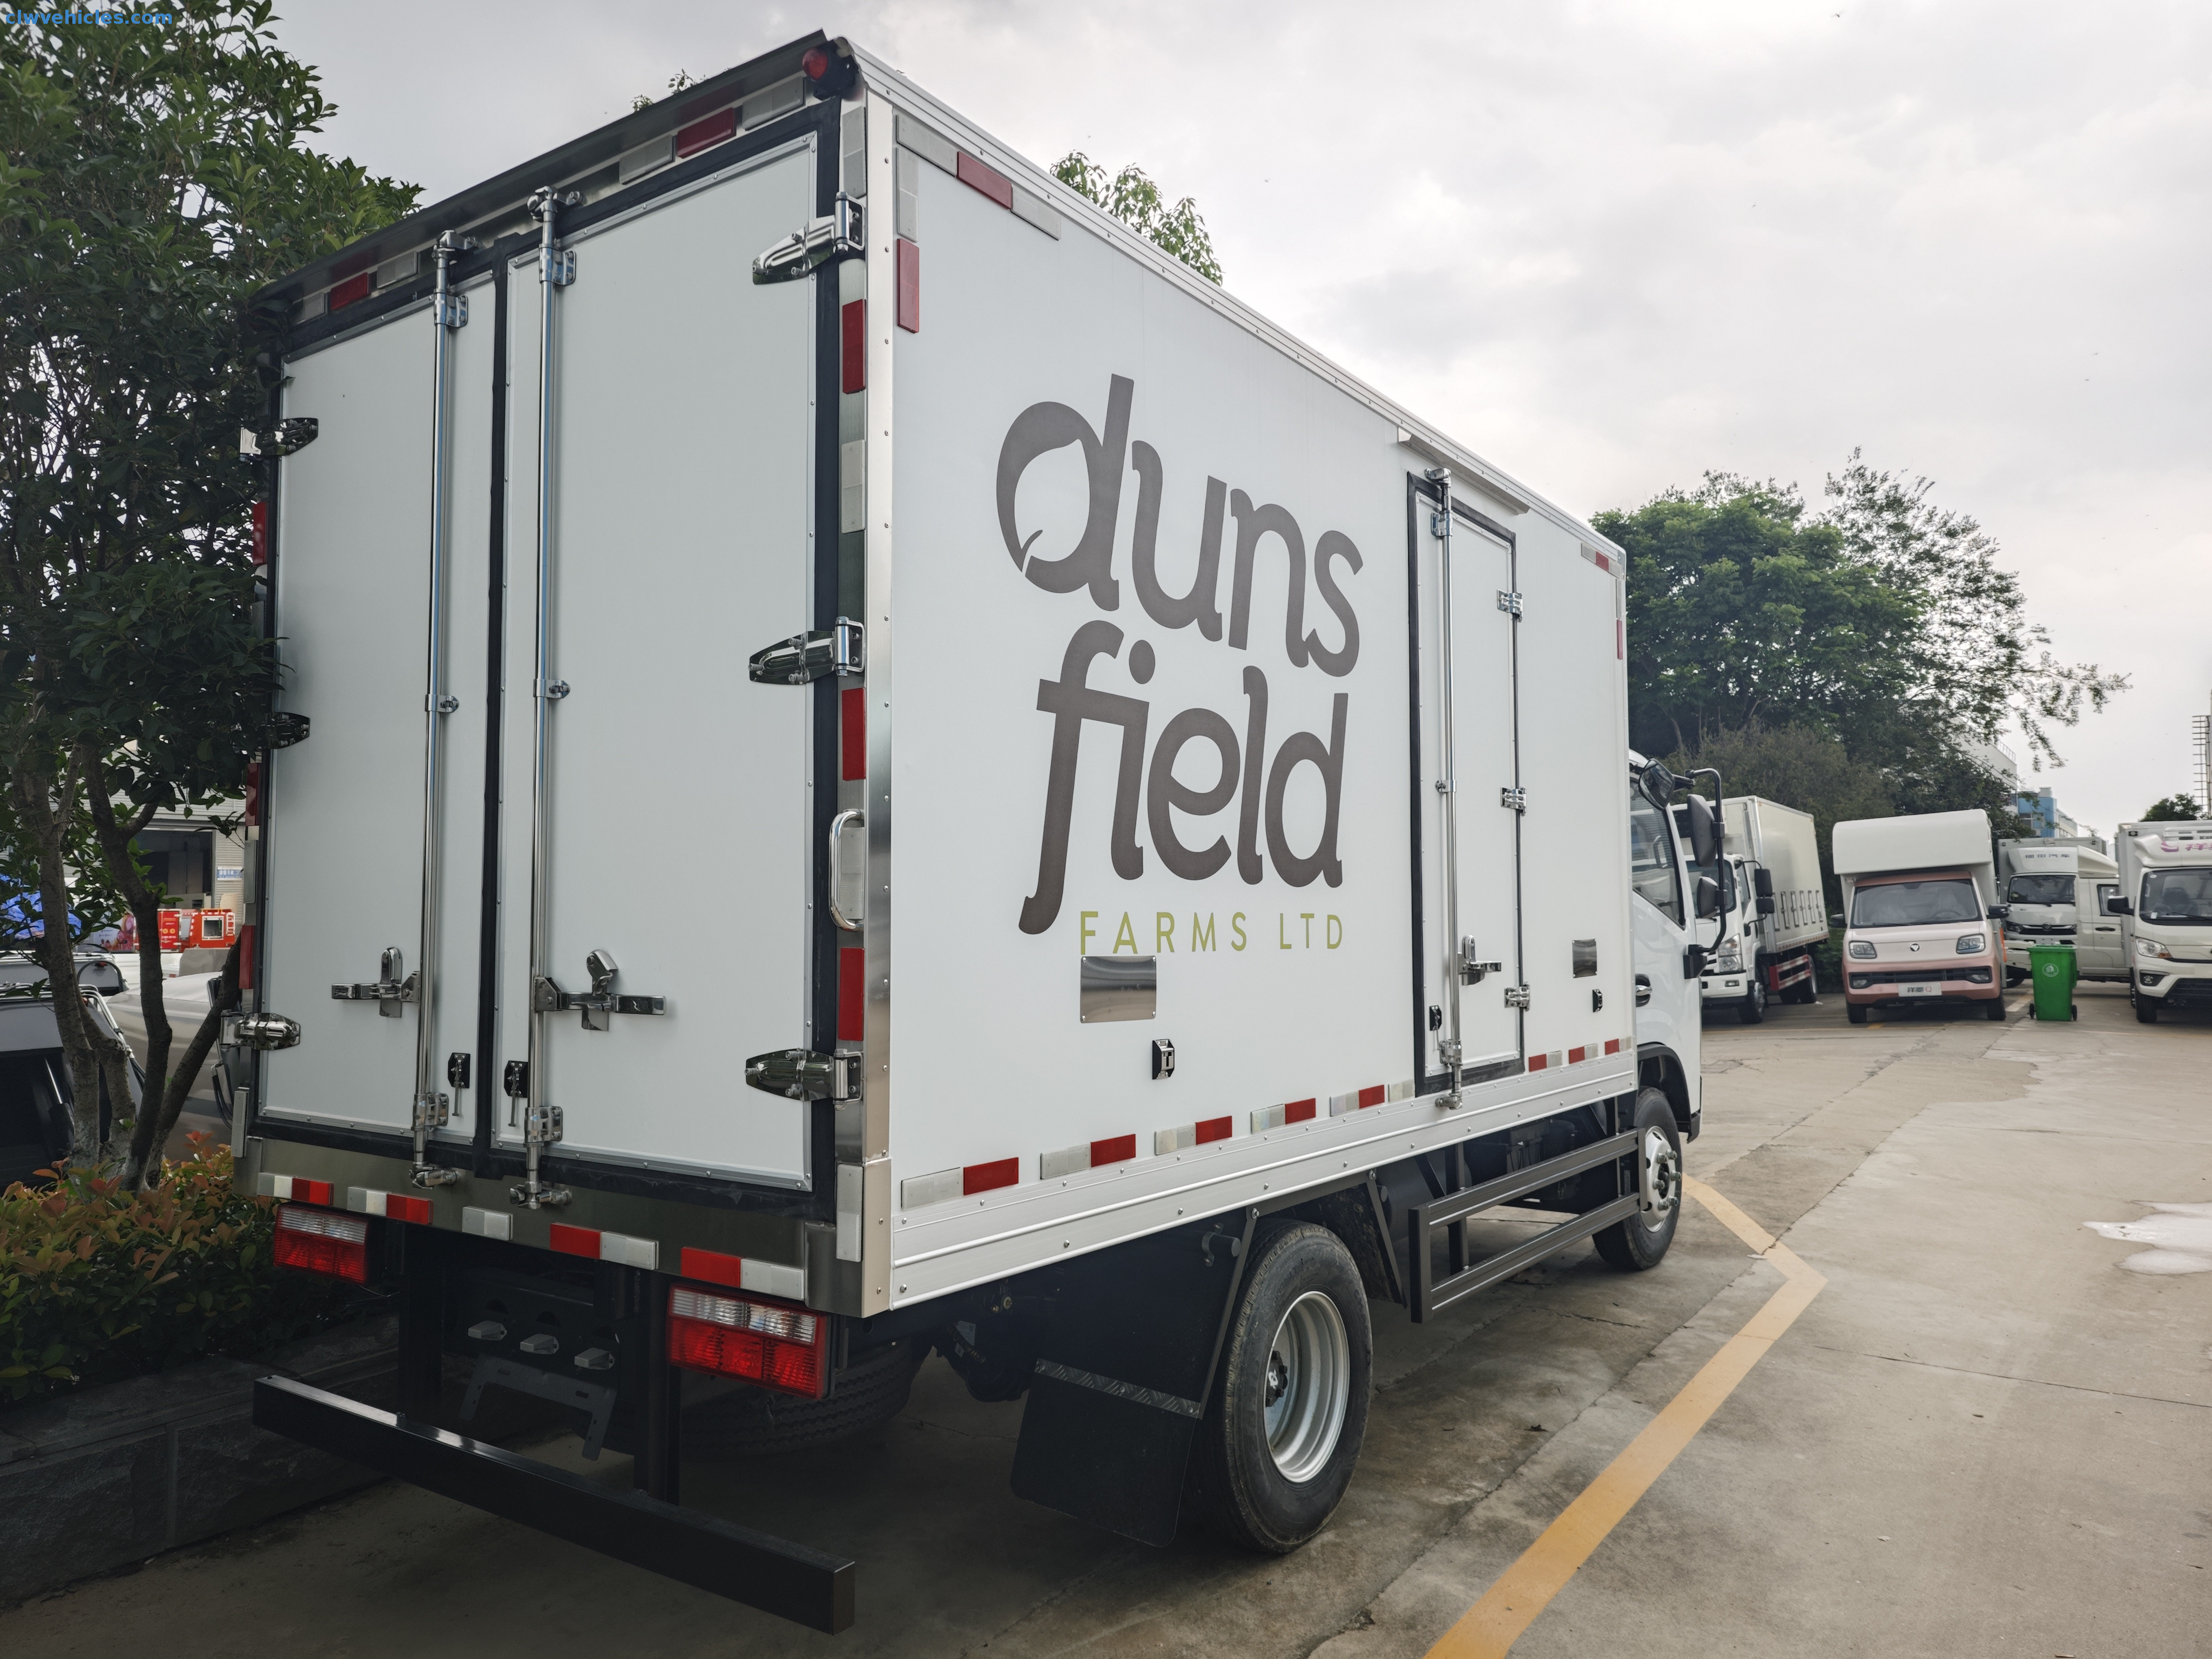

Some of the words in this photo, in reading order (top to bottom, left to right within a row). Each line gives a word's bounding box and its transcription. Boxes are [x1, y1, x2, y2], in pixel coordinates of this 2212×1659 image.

[996, 373, 1364, 677] duns
[1019, 620, 1348, 935] field
[1080, 911, 1247, 955] FARMS
[1279, 913, 1343, 950] LTD
